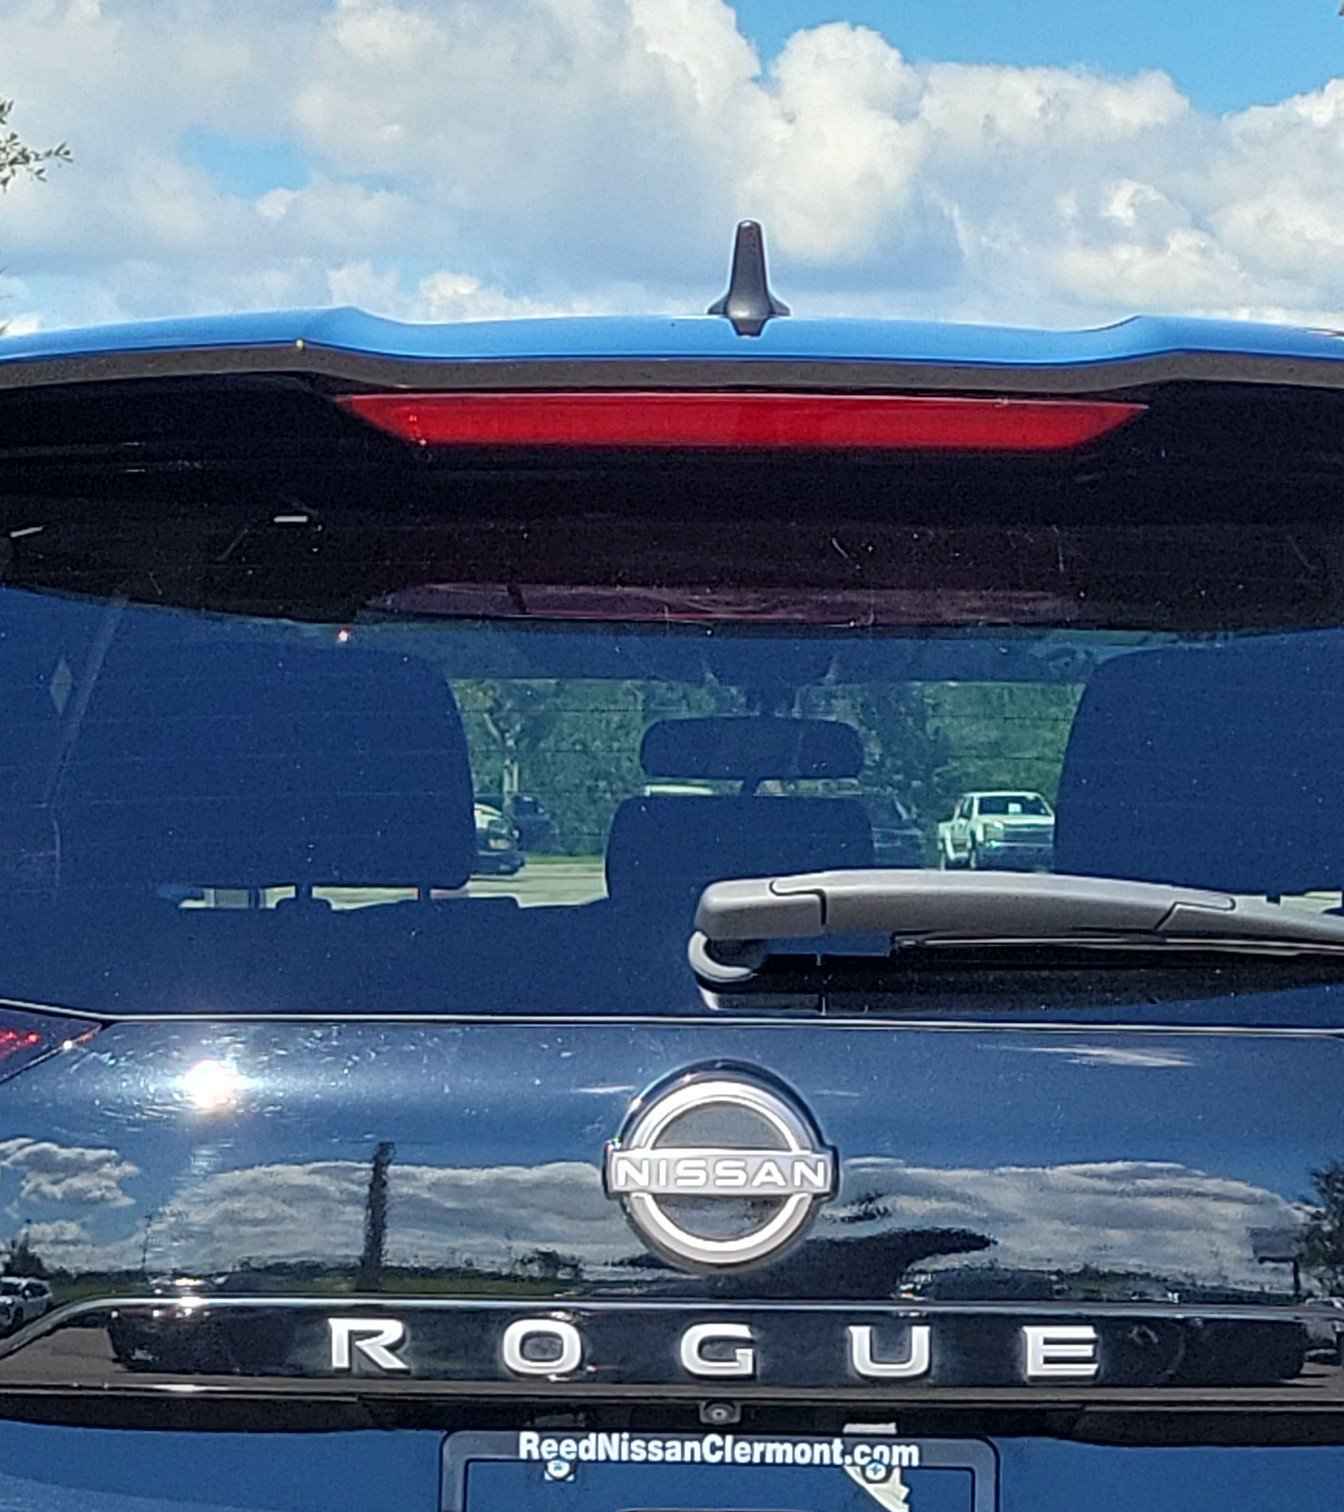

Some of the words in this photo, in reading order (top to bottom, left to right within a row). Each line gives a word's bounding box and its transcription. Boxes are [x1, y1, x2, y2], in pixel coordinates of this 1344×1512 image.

[615, 1158, 826, 1188] NISSAN
[327, 1317, 1099, 1378] ROGUE
[518, 1431, 920, 1467] ReedNissanClermont.com
